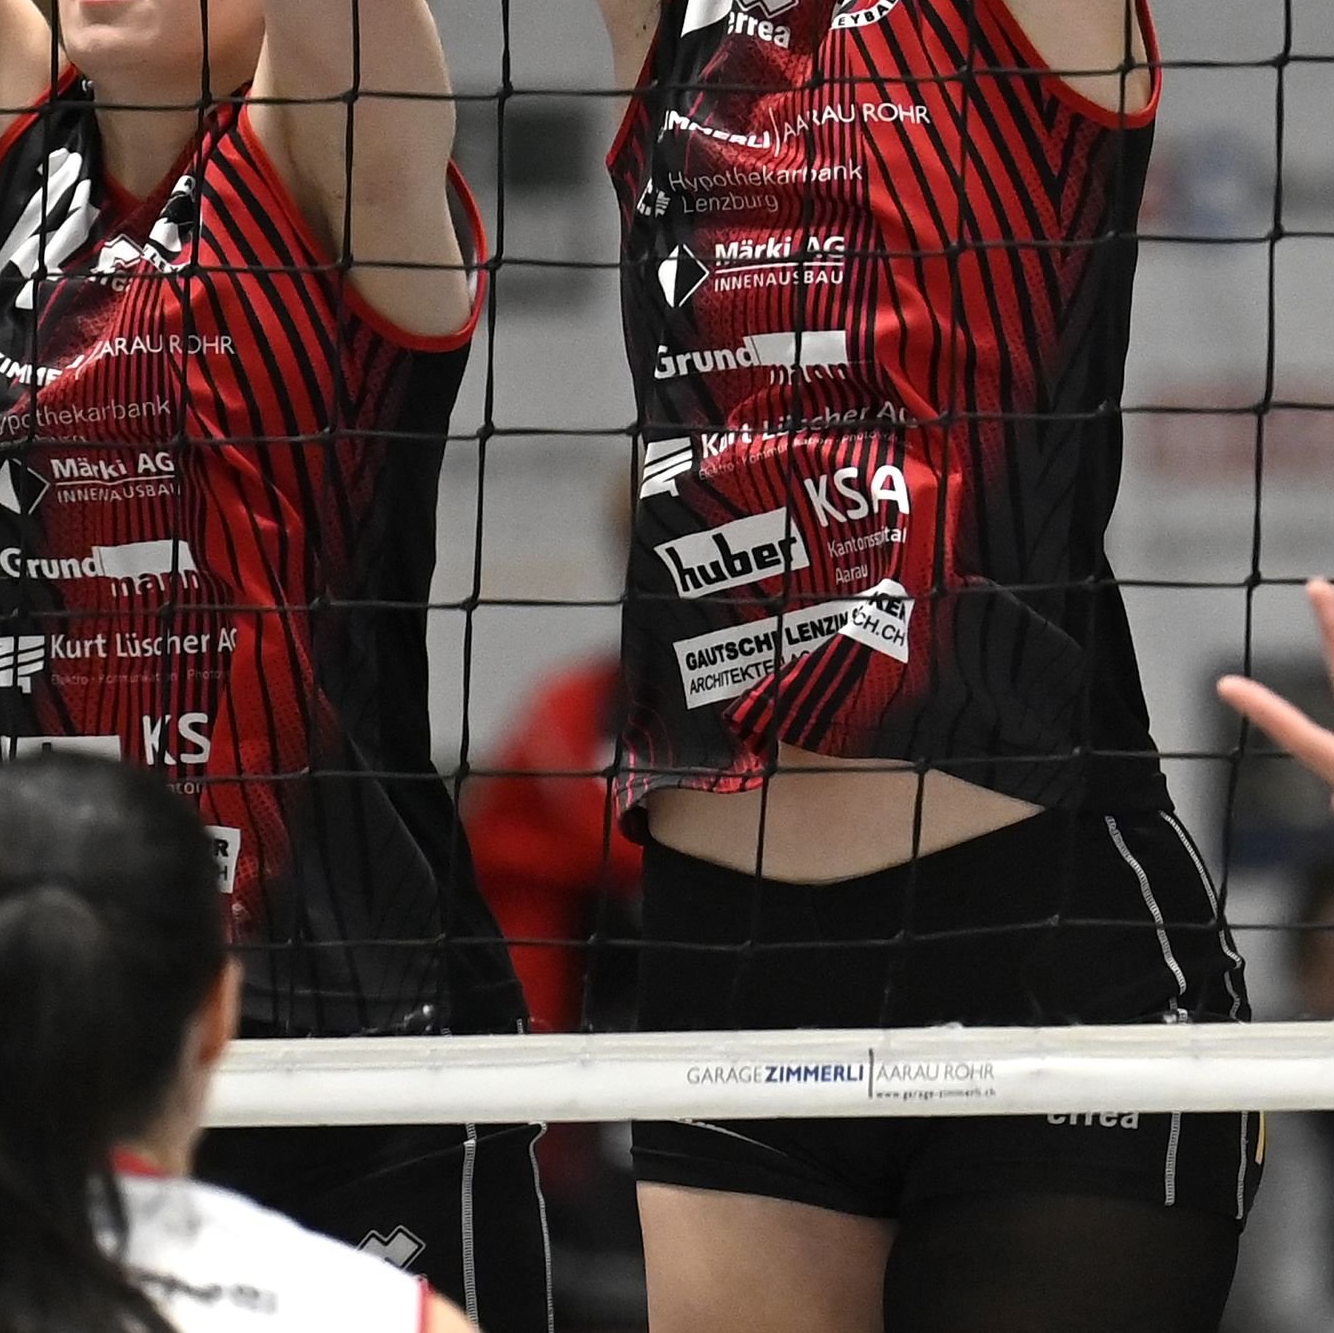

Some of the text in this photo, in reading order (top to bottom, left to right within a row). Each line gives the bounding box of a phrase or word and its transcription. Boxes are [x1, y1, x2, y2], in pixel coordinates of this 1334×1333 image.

[863, 102, 931, 124] ROHR
[682, 192, 779, 215] Lenzburg
[50, 451, 176, 480] Märki AG
[804, 465, 911, 527] KSA
[665, 532, 798, 592] huber
[51, 633, 107, 659] Kurt
[116, 630, 210, 658] Lüscher
[875, 1063, 940, 1081] AARAU
[944, 1063, 995, 1080] ROHR
